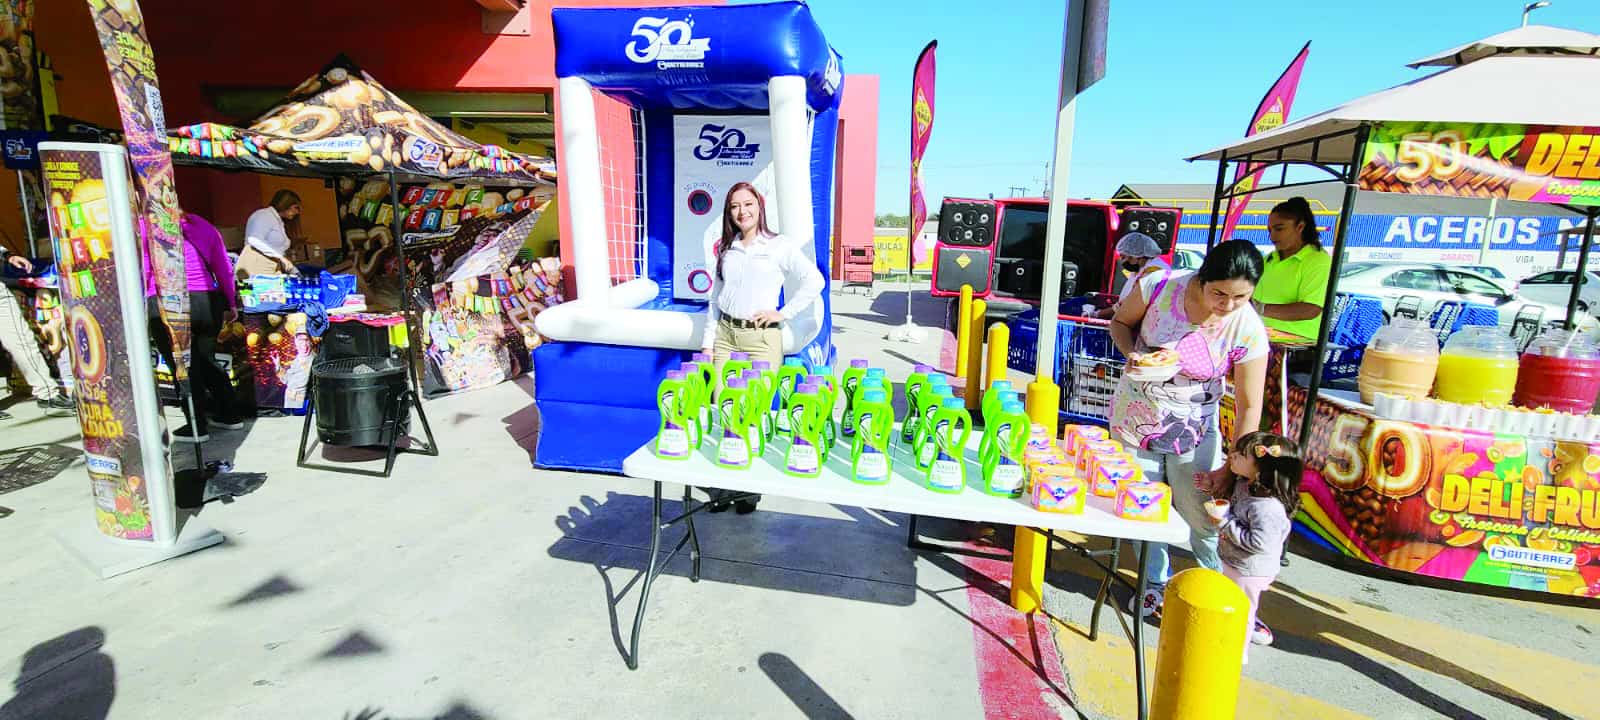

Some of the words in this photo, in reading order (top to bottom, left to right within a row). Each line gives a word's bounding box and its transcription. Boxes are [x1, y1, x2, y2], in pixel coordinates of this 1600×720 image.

[625, 16, 692, 63] 50
[693, 123, 746, 161] 50
[1397, 130, 1463, 184] 50
[1384, 216, 1540, 246] ACEROS
[1324, 412, 1433, 499] 50
[1440, 473, 1525, 520] DELI
[1506, 548, 1575, 566] GUTIERREZ
